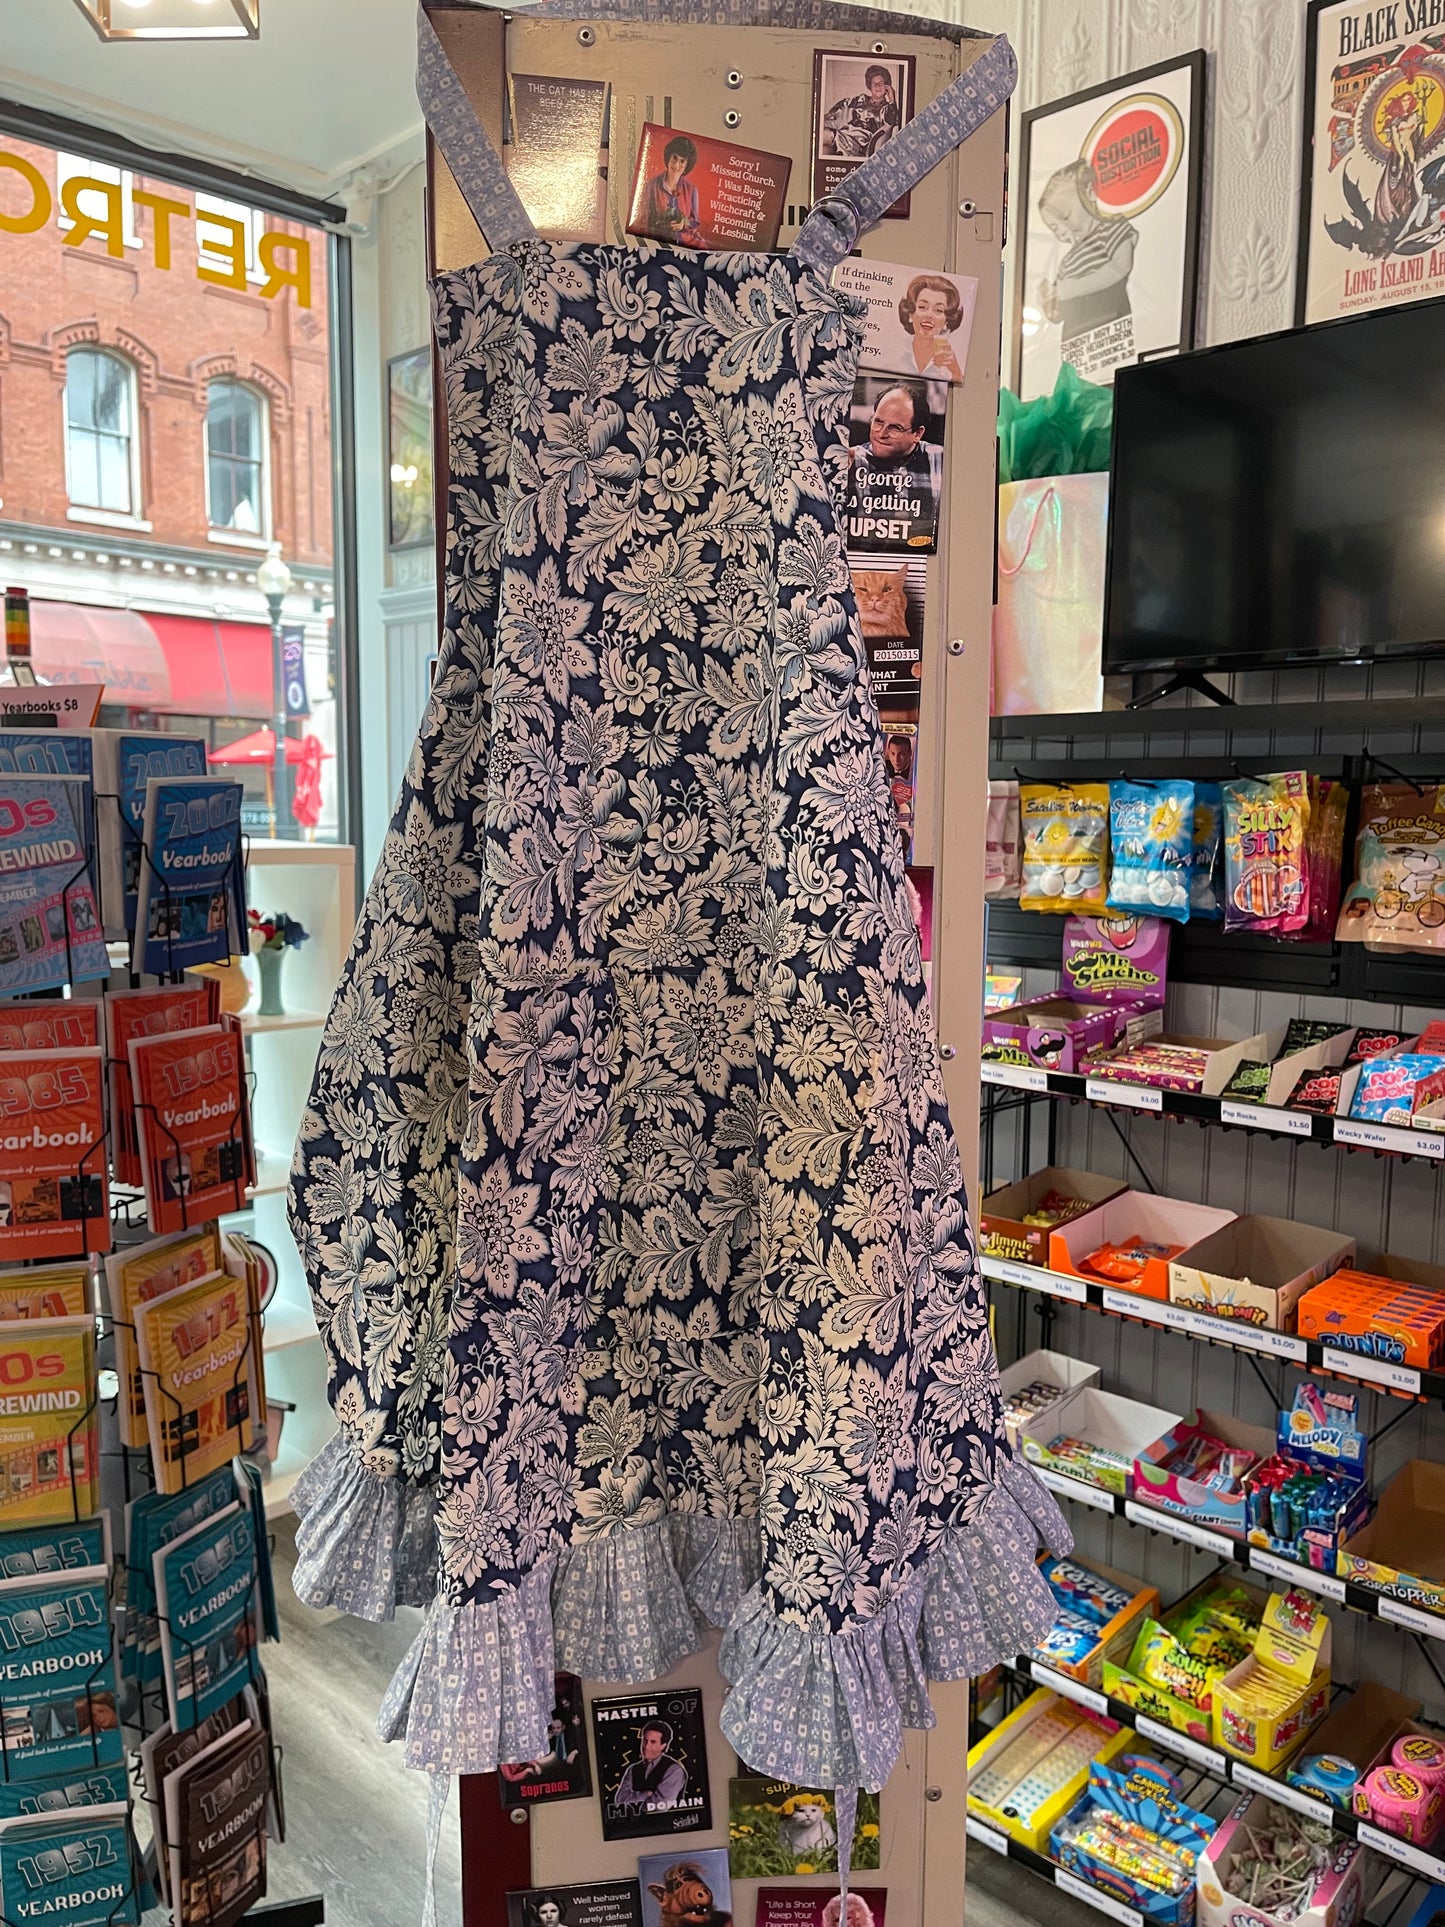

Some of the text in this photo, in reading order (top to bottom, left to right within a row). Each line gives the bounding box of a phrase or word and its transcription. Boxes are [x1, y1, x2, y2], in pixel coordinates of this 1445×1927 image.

[1339, 0, 1445, 57] BLACK SAB
[528, 83, 546, 94] THE
[549, 85, 566, 96] CAT
[1097, 124, 1160, 170] SOCIAL
[729, 156, 760, 172] Sorry I
[1100, 143, 1161, 184] DISTORTION
[710, 163, 776, 188] Missed Church.
[826, 175, 844, 183] the
[717, 190, 762, 210] Practicing
[718, 179, 765, 199] I Was Busy
[710, 200, 766, 221] Witchcraft &
[712, 224, 756, 243] A Lesbian.
[714, 212, 758, 233] Becoming
[842, 267, 894, 285] If drinking
[1344, 248, 1445, 297] LONG ISLAND AR
[855, 282, 870, 291] the
[1381, 285, 1417, 301] AUGUST
[1435, 281, 1445, 291] 19
[865, 297, 893, 308] porch
[855, 466, 912, 492] George
[847, 494, 920, 517] s getting
[849, 517, 912, 539] UPSET
[875, 650, 918, 660] 20150315
[2, 699, 78, 714] Yearbooks $8
[129, 746, 200, 790] 2003
[165, 788, 240, 840] 2002
[1237, 807, 1294, 834] SILLY
[1370, 817, 1413, 836] Toffee
[1241, 829, 1293, 857] STIX
[162, 842, 232, 870] Yearbook
[1100, 954, 1131, 968] Mr.
[1075, 967, 1158, 987] Stache
[0, 1016, 87, 1049] 984
[1358, 1035, 1399, 1052] POP
[162, 1041, 235, 1098] 1986
[1369, 1067, 1409, 1087] POP
[0, 1066, 89, 1117] 985
[1141, 1096, 1159, 1105] $3.00
[163, 1093, 236, 1128] Yearbook
[1222, 1109, 1310, 1130] Pop Rocks $1.50
[0, 1122, 93, 1151] arbook
[1337, 1128, 1441, 1151] Wacky Wafer $3.00
[989, 1231, 1033, 1251] Jimmie
[997, 1245, 1026, 1260] Stix
[171, 1291, 240, 1361] 1972
[1193, 1316, 1264, 1342] Whatchamacallit
[171, 1339, 243, 1390] Yearbook
[1291, 1431, 1341, 1446] MELODY
[180, 1520, 252, 1596] 1956
[178, 1573, 252, 1629] YEARBOOK
[0, 1591, 103, 1650] 1954
[0, 1650, 104, 1681] YEARBOOK
[1165, 1650, 1207, 1679] SOUR
[597, 1699, 697, 1721] MASTER OF
[200, 1743, 266, 1824] 1940
[520, 1780, 570, 1797] sopranos
[20, 1775, 117, 1816] 1953
[607, 1797, 704, 1819] MY DOMAIN
[198, 1793, 266, 1854] YEARBOOK
[17, 1834, 119, 1889] 1952
[17, 1883, 124, 1918] YEARBOOK
[572, 1892, 631, 1905] Well behaved
[588, 1904, 620, 1913] women
[794, 1901, 817, 1910] Short,
[579, 1911, 633, 1924] rarely defeat
[769, 1912, 812, 1920] Keep Your
